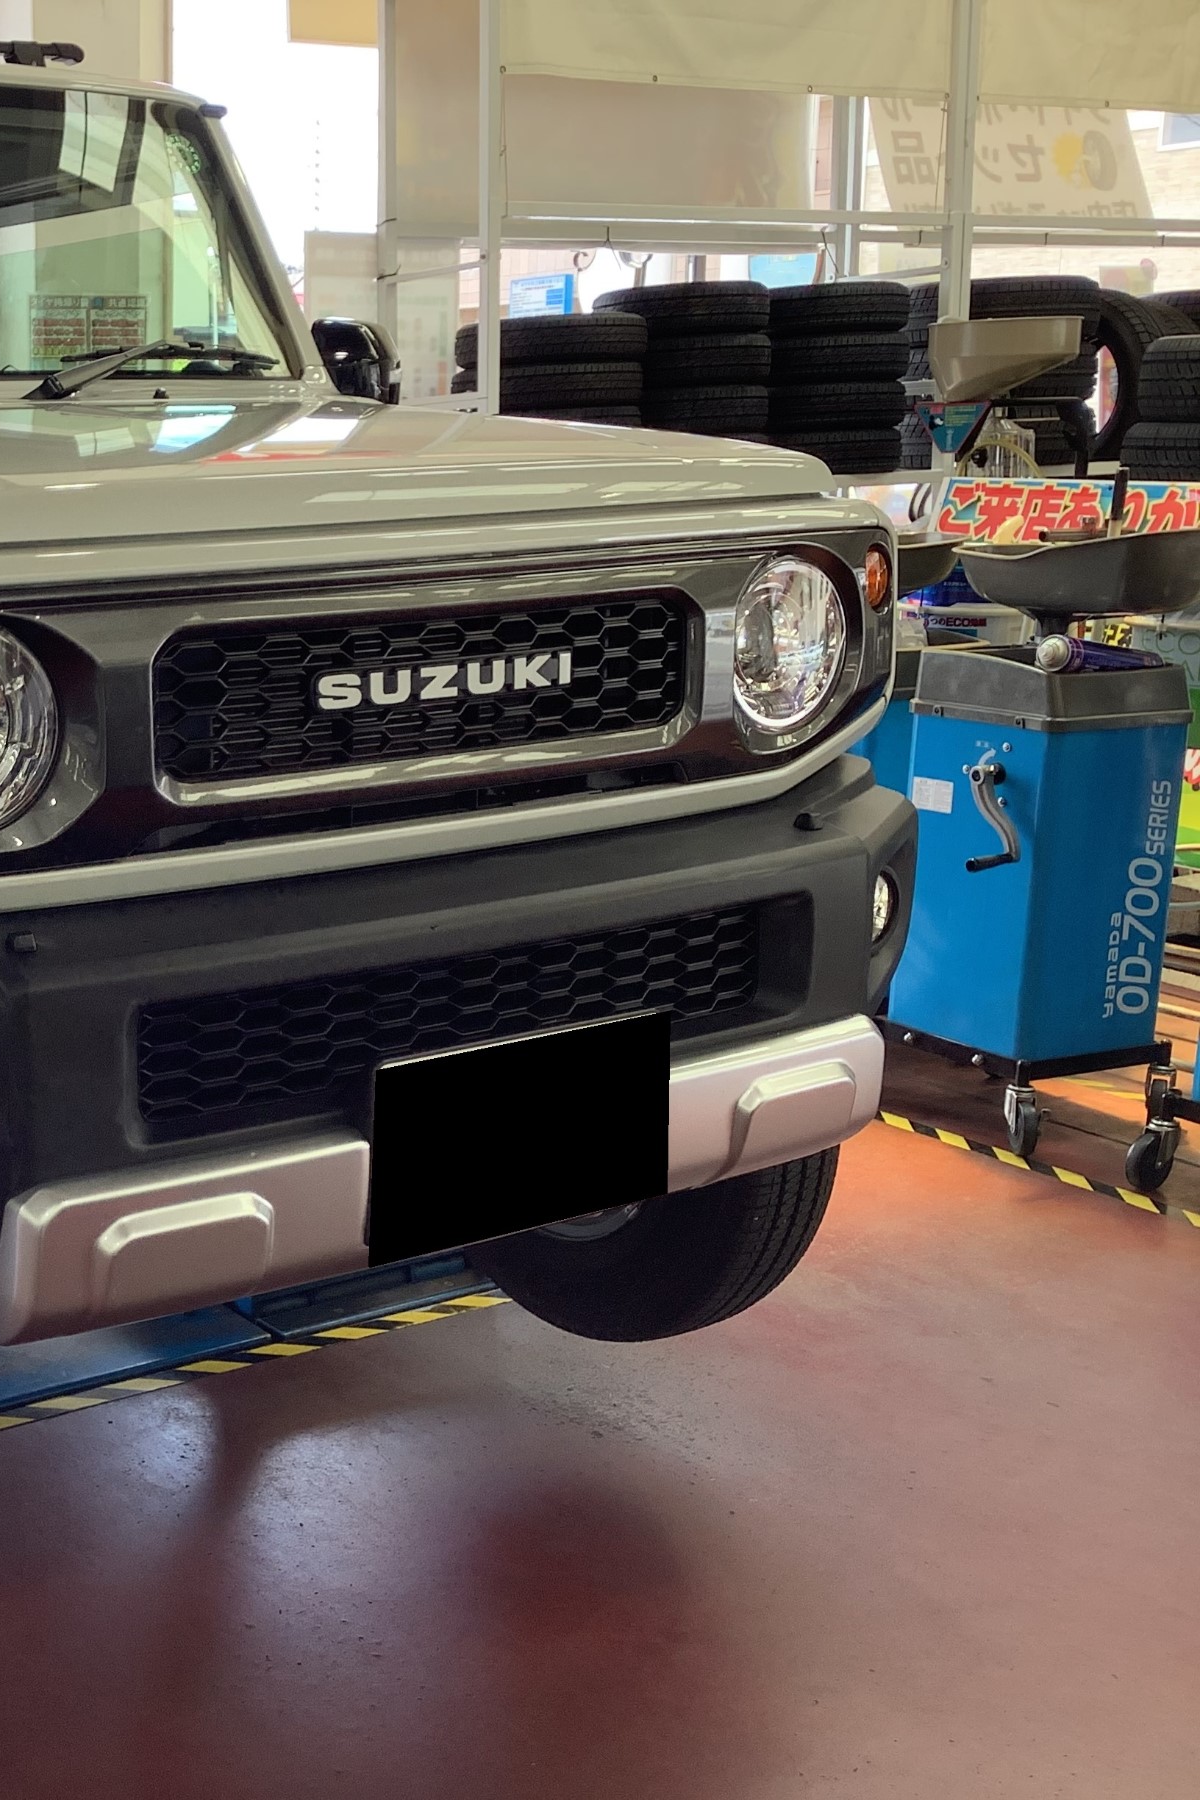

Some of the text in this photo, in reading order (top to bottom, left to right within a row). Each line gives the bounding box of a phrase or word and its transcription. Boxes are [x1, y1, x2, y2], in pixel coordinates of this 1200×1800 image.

[317, 652, 572, 711] SUZUKI
[1115, 780, 1172, 1016] OD-700 SERIES
